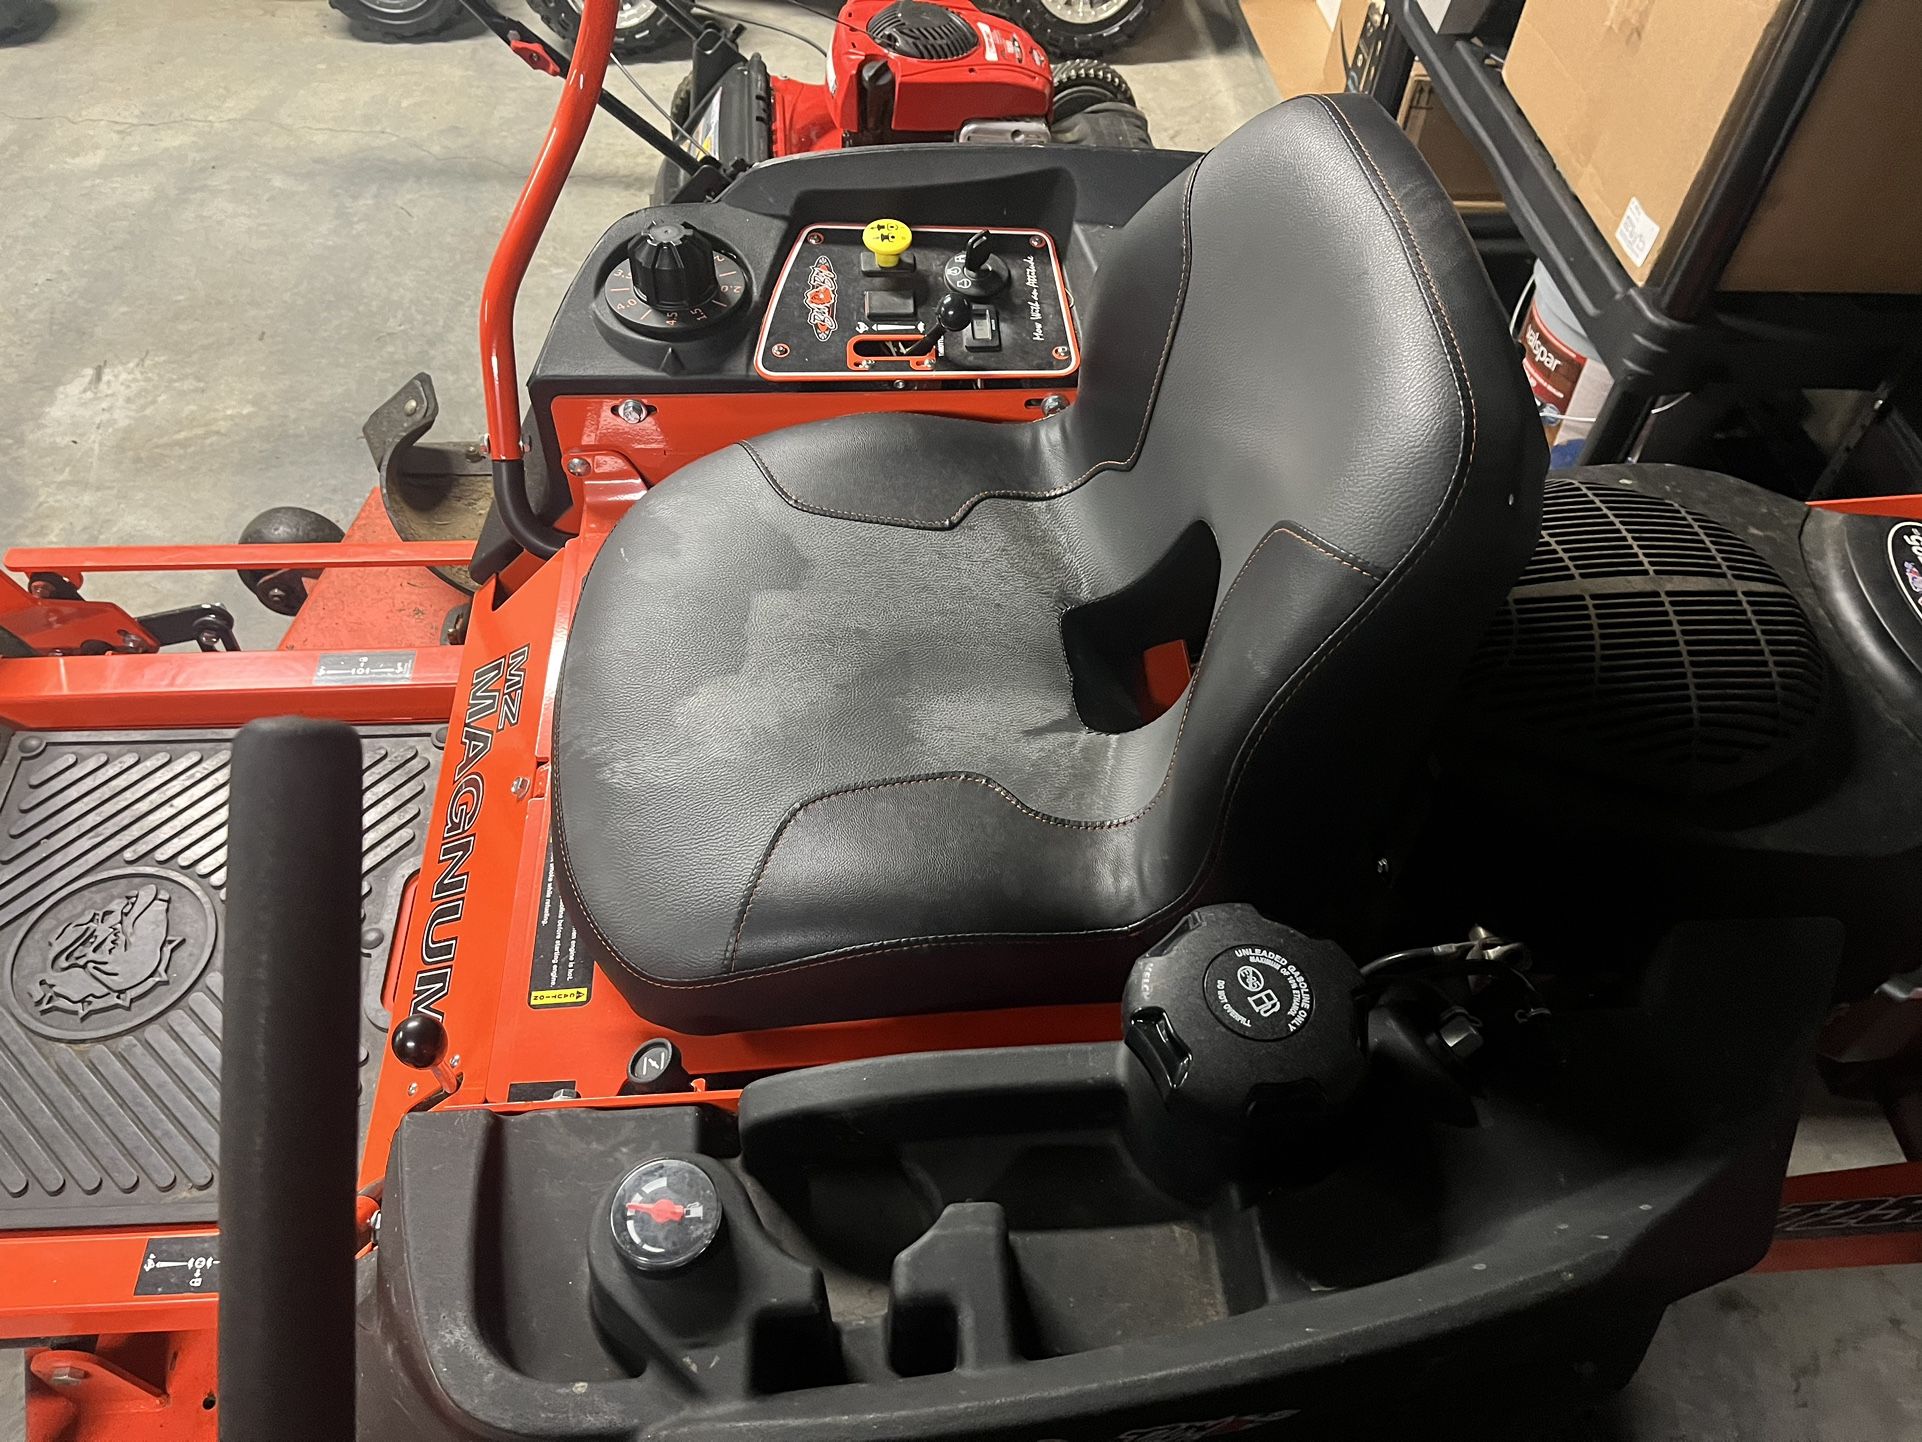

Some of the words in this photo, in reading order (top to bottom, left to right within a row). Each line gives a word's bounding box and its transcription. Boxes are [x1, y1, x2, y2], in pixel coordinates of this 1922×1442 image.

[1023, 255, 1039, 288] Attitude
[1031, 288, 1039, 301] an
[617, 298, 637, 311] 4.0
[1027, 301, 1042, 320] With
[665, 312, 678, 326] 4.5
[690, 308, 707, 321] 1.5
[1032, 322, 1045, 341] Mow
[497, 643, 530, 733] MZ
[547, 863, 555, 882] smoke
[545, 882, 553, 898] while
[555, 919, 565, 939] before
[551, 939, 562, 964] starting
[567, 940, 577, 961] engine
[1234, 948, 1288, 966] UNLEADED
[567, 961, 576, 969] is
[549, 964, 559, 988] engine.
[566, 968, 575, 982] hot.
[1216, 979, 1226, 990] DO
[1249, 956, 1282, 971] MAXIMUM
[1286, 989, 1301, 1017] ETHANOL
[1287, 964, 1311, 1010] GASOLINE
[533, 992, 576, 1001] CAUTION
[1217, 990, 1229, 1003] NOT
[1287, 1009, 1308, 1032] ONLY
